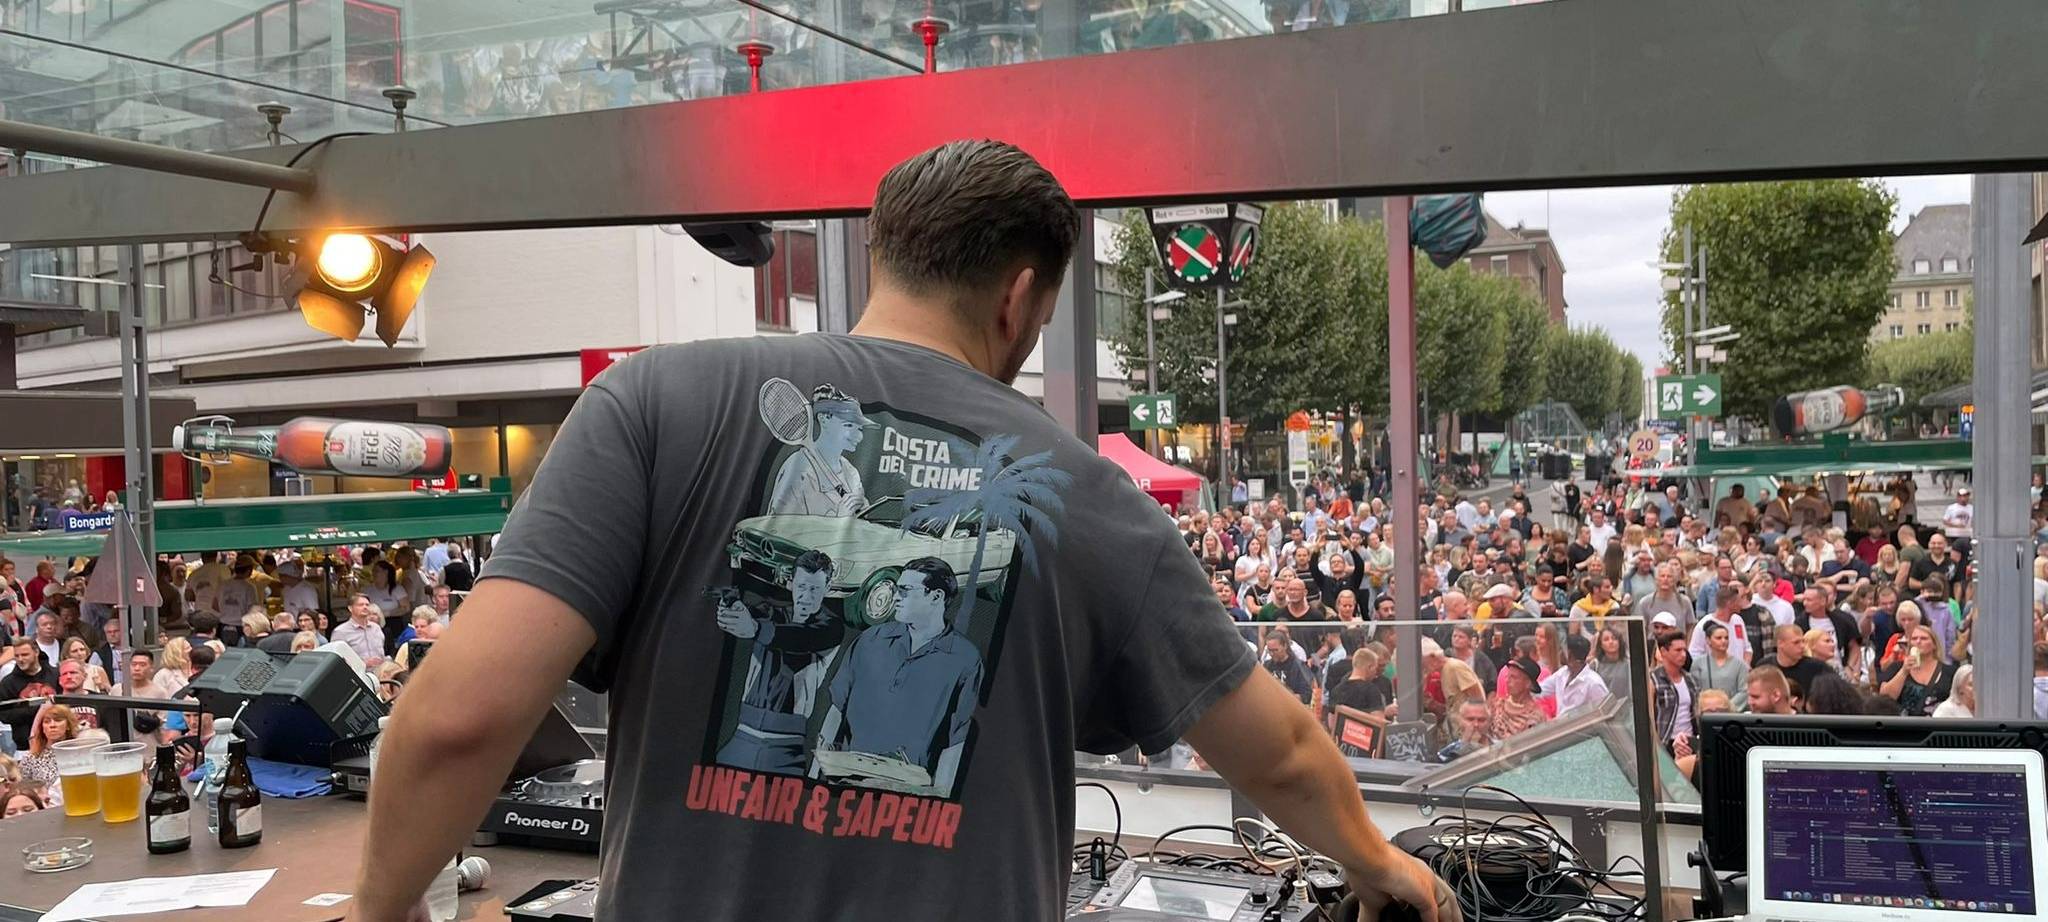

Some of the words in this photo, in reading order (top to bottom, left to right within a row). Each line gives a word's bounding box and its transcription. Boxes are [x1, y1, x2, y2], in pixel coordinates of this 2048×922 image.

[361, 430, 379, 468] FIEGE
[383, 434, 402, 468] Pils
[883, 426, 950, 464] COSTA
[1637, 438, 1653, 451] 20
[878, 455, 906, 475] DEL
[909, 464, 983, 491] CRIME
[505, 812, 568, 829] Pioneer
[686, 765, 804, 824] UNFAIR
[802, 785, 831, 834] &
[833, 790, 962, 848] SAPEUR
